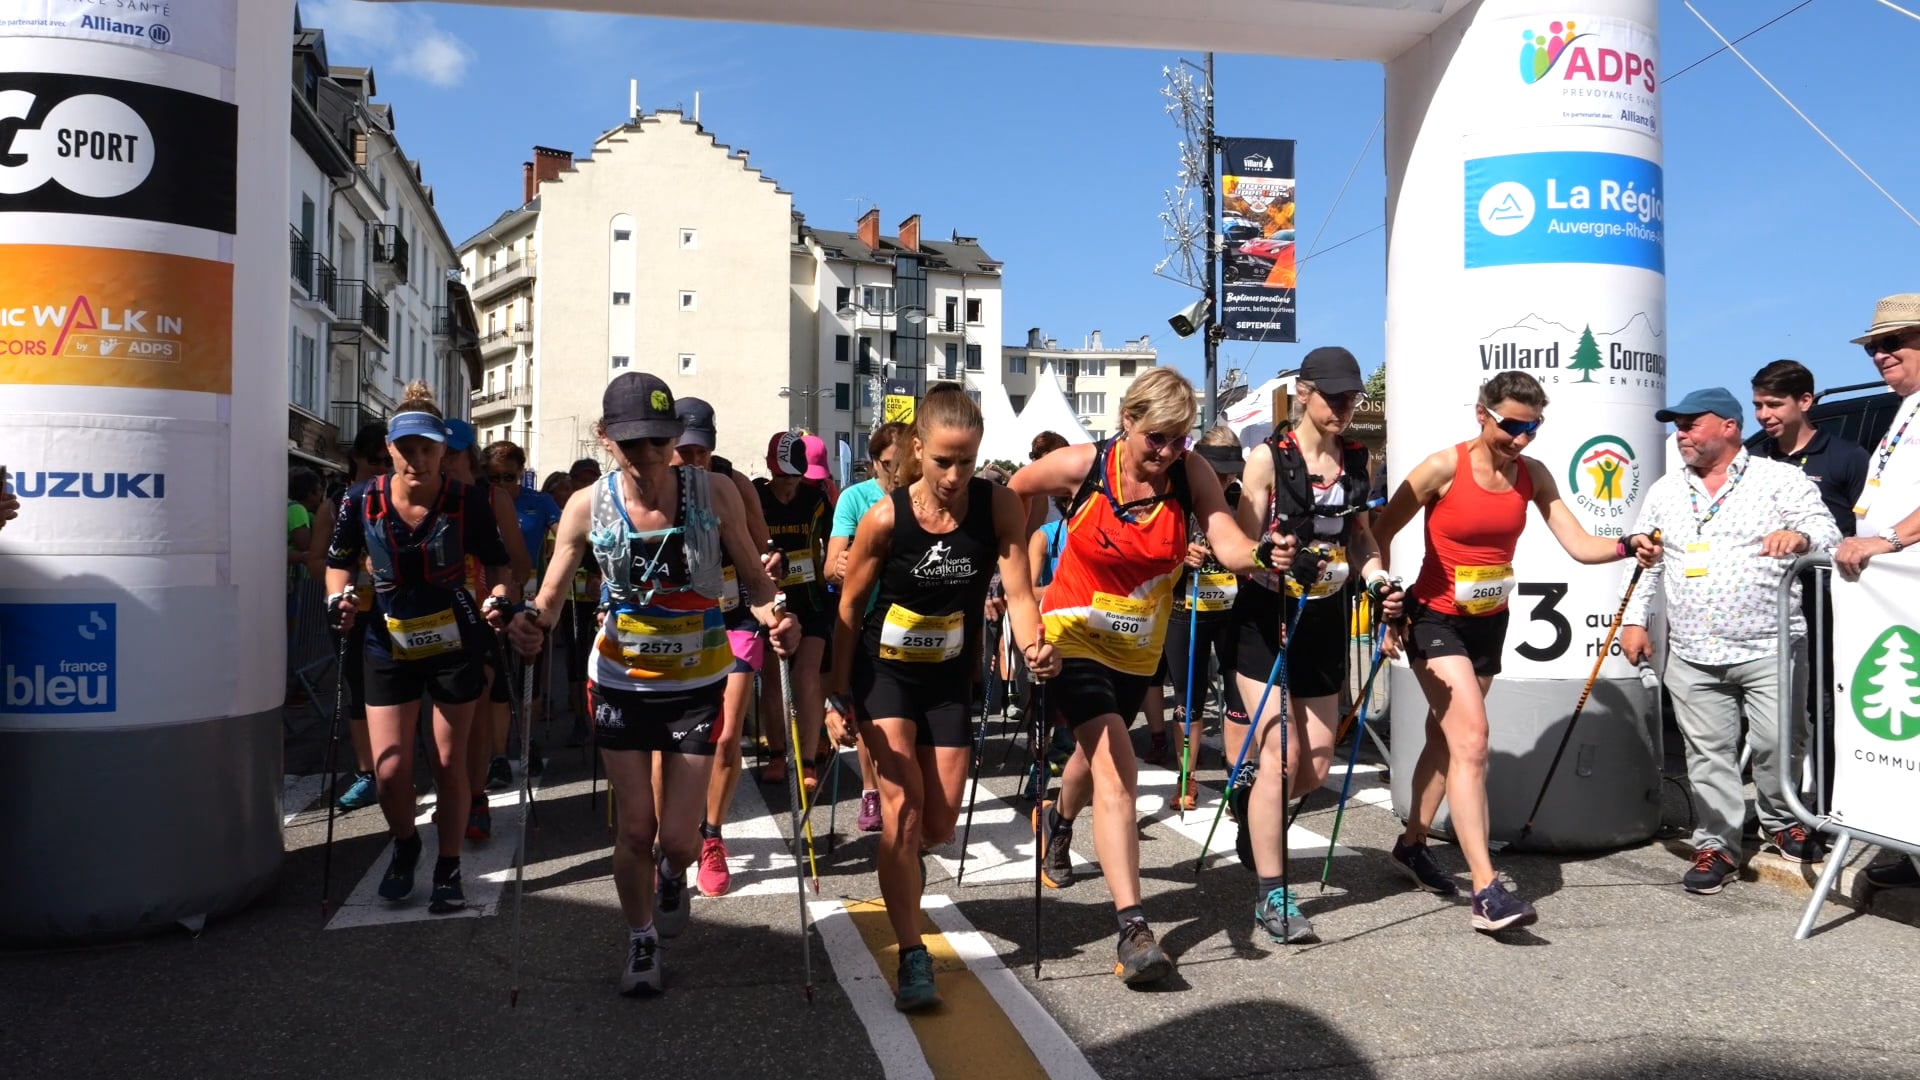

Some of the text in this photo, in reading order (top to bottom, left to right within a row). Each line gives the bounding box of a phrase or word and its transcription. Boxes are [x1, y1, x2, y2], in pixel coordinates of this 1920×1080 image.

[7, 19, 48, 28] partenariat
[49, 20, 66, 28] avec
[81, 14, 145, 37] Allianz
[1563, 47, 1656, 94] ADPS
[1620, 109, 1650, 127] Allianz
[57, 128, 138, 163] SPORT
[1547, 178, 1590, 209] La
[1252, 305, 1270, 313] belles
[157, 315, 182, 336] IN
[1236, 321, 1282, 330] SEPTEMBRE
[76, 341, 173, 356] by ADPS
[1479, 341, 1559, 370] Villard
[1610, 376, 1627, 385] EN
[1349, 422, 1382, 431] Aquatique
[5, 472, 165, 498] UZUKI
[1610, 505, 1624, 517] DE
[1625, 463, 1640, 508] FRANCE
[1594, 523, 1623, 537] Isère
[923, 563, 972, 576] walking
[1200, 591, 1225, 599] 2572
[1472, 586, 1503, 599] 2603
[1112, 620, 1139, 633] 690
[1515, 582, 1572, 662] 3
[407, 633, 443, 647] 1023
[902, 636, 944, 648] 2587
[640, 642, 683, 654] 2573
[60, 660, 107, 673] france
[7, 664, 107, 706] bleu
[1854, 749, 1920, 772] COMMU
